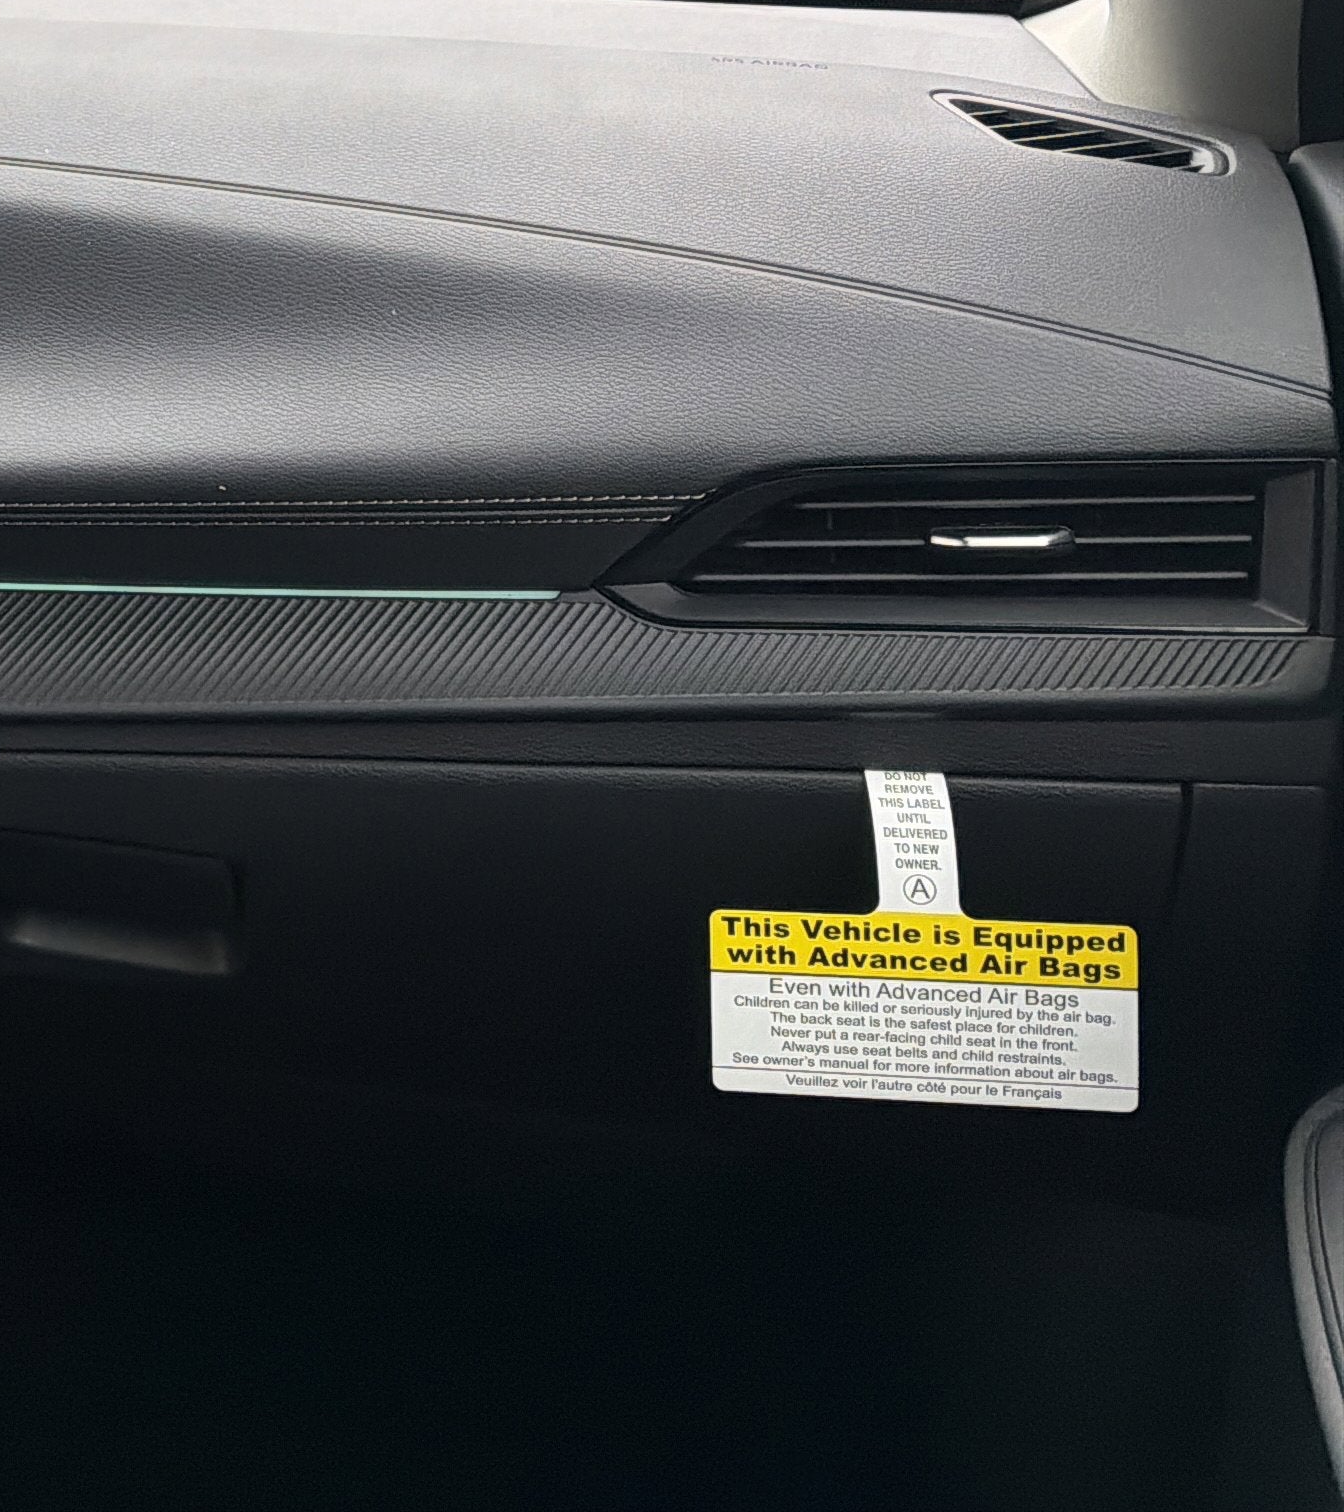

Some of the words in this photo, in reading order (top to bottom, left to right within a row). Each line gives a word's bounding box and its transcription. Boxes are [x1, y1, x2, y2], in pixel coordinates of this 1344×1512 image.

[884, 772, 901, 781] DO
[884, 784, 934, 795] REMOVE
[878, 797, 904, 808] THIS
[907, 798, 945, 810] LABEL
[897, 812, 931, 824] UNTIL
[883, 827, 948, 840] DELIVERED
[894, 842, 910, 854] TO
[913, 844, 939, 855] NEW
[895, 858, 942, 870] OWNER.
[910, 878, 931, 899] A
[721, 916, 790, 938] This
[801, 919, 921, 943] Vehicle
[933, 925, 961, 945] is
[973, 926, 1126, 955] Equipped
[727, 944, 796, 965] with
[808, 946, 967, 973] Advanced
[980, 954, 1028, 976] Air
[1039, 956, 1121, 984] Bags
[769, 978, 821, 996] Even
[829, 981, 870, 998] with
[876, 982, 981, 1003] Advanced
[987, 988, 1018, 1005] Air
[1025, 989, 1079, 1010] Bags
[734, 995, 790, 1009] Children
[794, 999, 819, 1010] can
[822, 1000, 840, 1012] be
[844, 1001, 879, 1013] killed
[882, 1003, 897, 1014] or
[900, 1004, 962, 1019] seriously
[966, 1007, 1012, 1020] injured
[1016, 1010, 1033, 1022] by
[1037, 1010, 1059, 1021] the
[1063, 1012, 1082, 1023] air
[1085, 1012, 1116, 1026] bag.
[770, 1012, 796, 1023] The
[800, 1013, 832, 1025] back
[836, 1016, 865, 1027] seat
[870, 1016, 881, 1027] is
[885, 1017, 906, 1029] the
[910, 1018, 952, 1031] safest
[956, 1021, 992, 1034] place
[997, 1022, 1016, 1034] for
[1019, 1023, 1079, 1037] children.
[771, 1026, 811, 1038] Never
[815, 1029, 836, 1041] put
[840, 1032, 848, 1040] a
[852, 1032, 926, 1046] rear-facing
[930, 1034, 962, 1046] child
[966, 1037, 996, 1048] seat
[1000, 1038, 1012, 1049] in
[1016, 1038, 1038, 1049] the
[1042, 1039, 1077, 1052] front.
[781, 1041, 829, 1055] Always
[833, 1045, 858, 1055] use
[862, 1045, 892, 1057] seat
[895, 1046, 928, 1059] belts
[932, 1049, 957, 1061] and
[962, 1050, 994, 1062] child
[998, 1053, 1066, 1066] restraints.
[732, 1052, 759, 1064] See
[763, 1055, 815, 1067] owner's
[819, 1058, 869, 1070] manual
[873, 1059, 892, 1071] for
[895, 1062, 930, 1073] more
[934, 1064, 1010, 1078] information
[1015, 1067, 1054, 1079] about
[1058, 1069, 1076, 1080] air
[1080, 1070, 1118, 1084] bags.
[786, 1074, 838, 1088] Veuillez
[842, 1077, 868, 1089] voir
[872, 1079, 913, 1092] l'autre
[917, 1080, 946, 1093] côté
[950, 1084, 982, 1096] pour
[986, 1084, 998, 1096] le
[1002, 1086, 1062, 1100] Français
